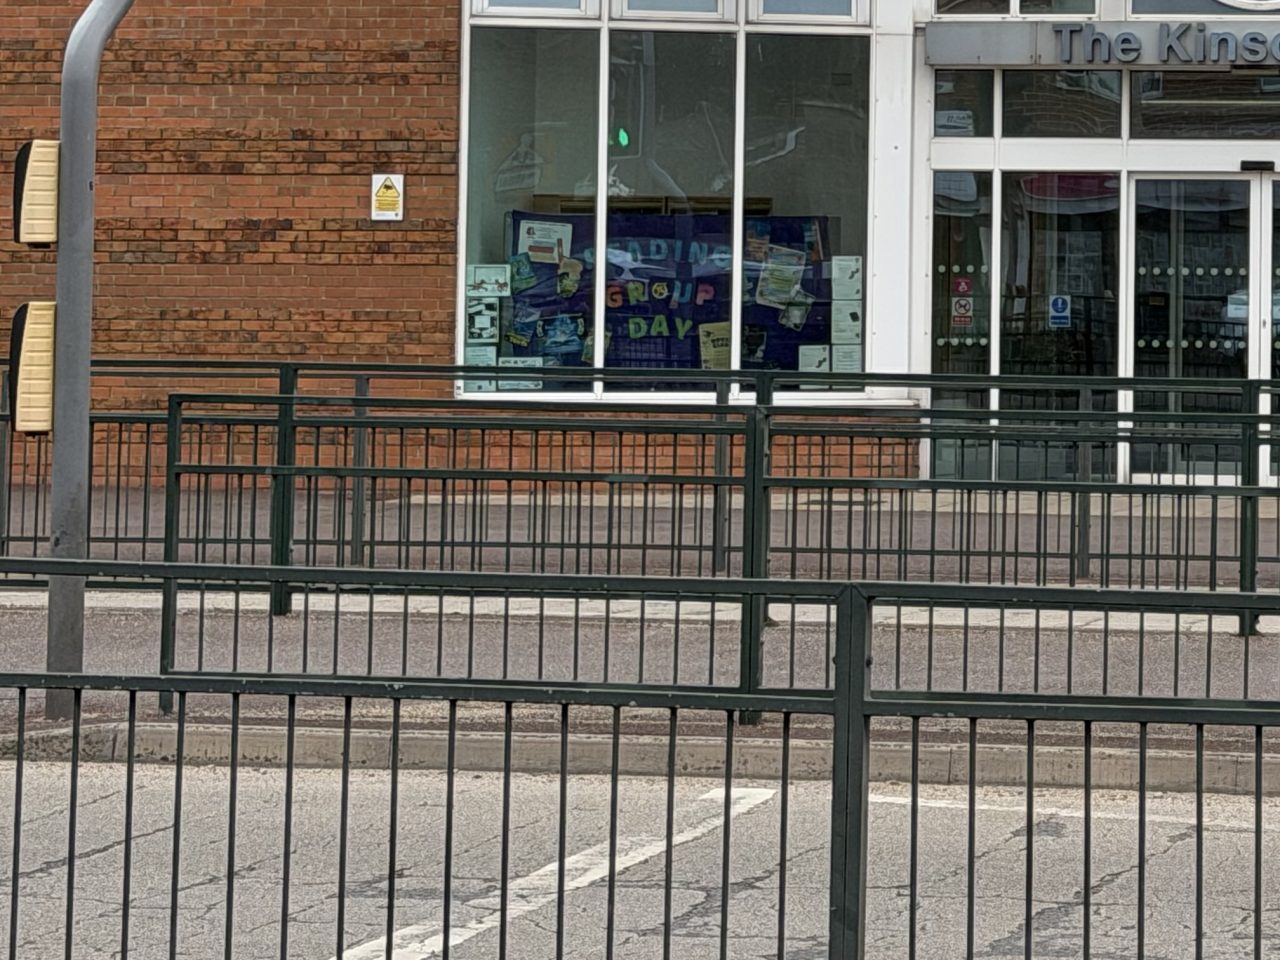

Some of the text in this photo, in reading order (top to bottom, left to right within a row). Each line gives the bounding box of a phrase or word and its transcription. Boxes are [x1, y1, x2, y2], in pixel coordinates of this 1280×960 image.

[1052, 23, 1141, 63] The
[607, 279, 715, 308] GROUP
[628, 314, 693, 340] DAY
